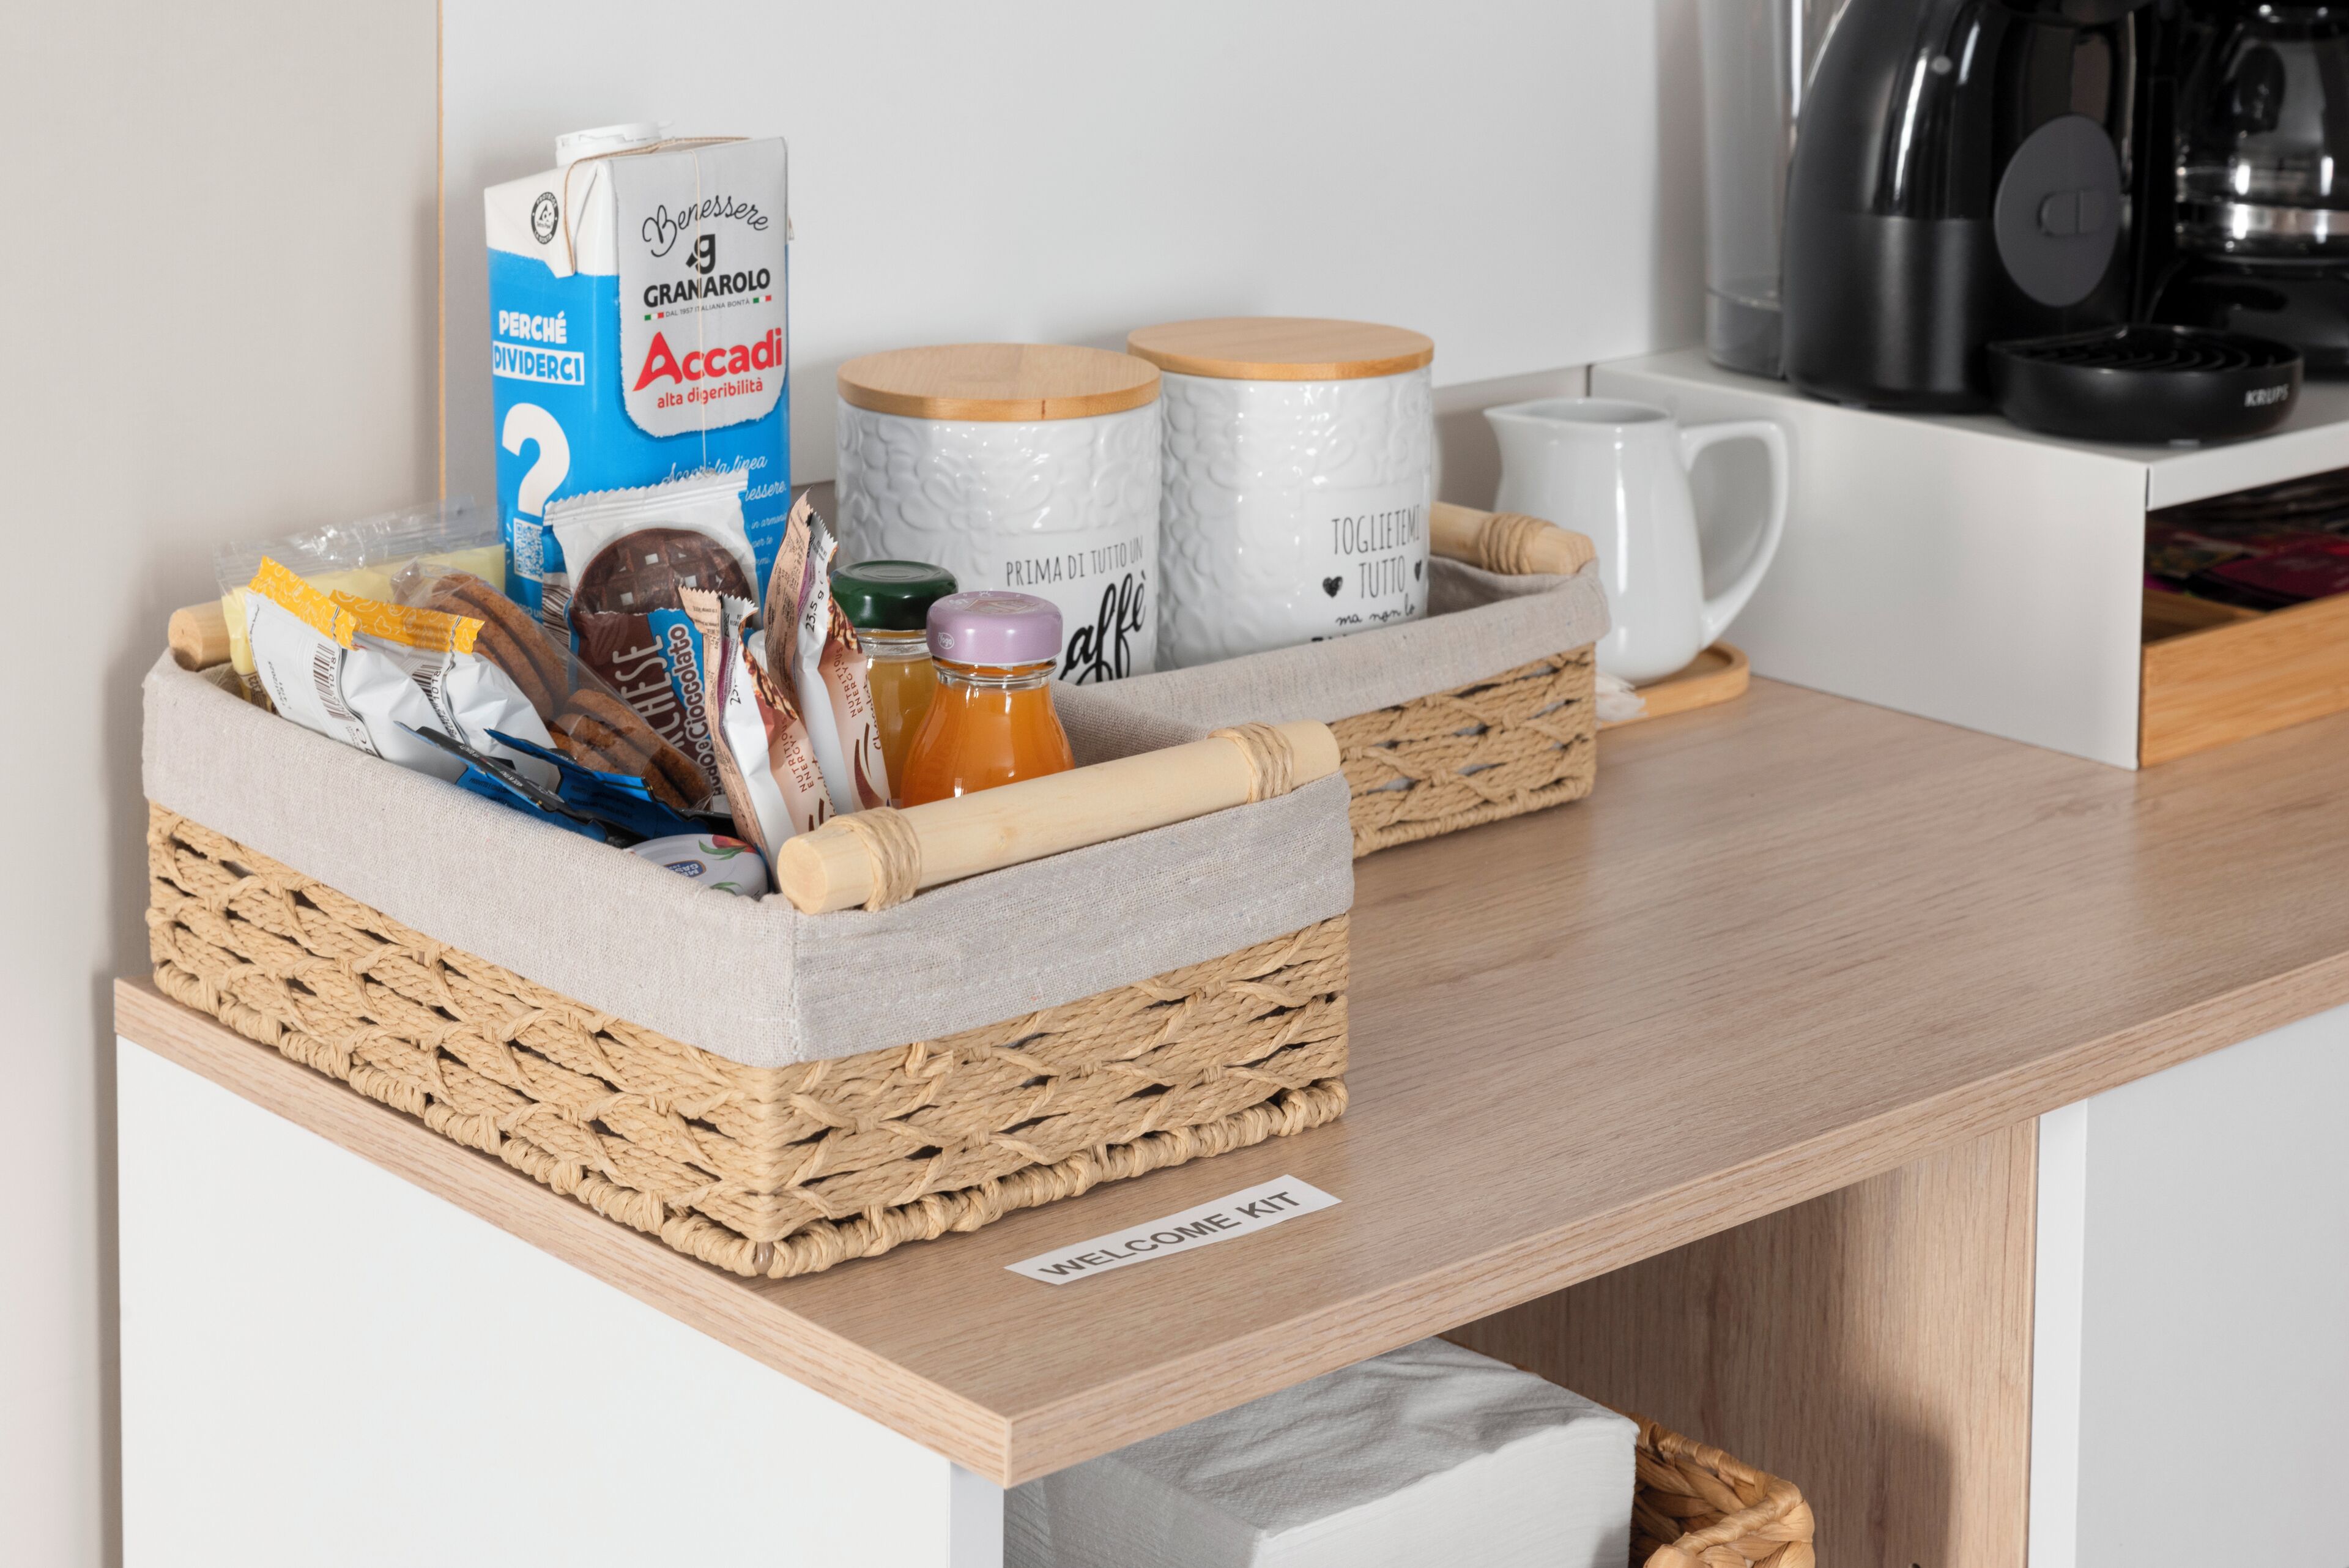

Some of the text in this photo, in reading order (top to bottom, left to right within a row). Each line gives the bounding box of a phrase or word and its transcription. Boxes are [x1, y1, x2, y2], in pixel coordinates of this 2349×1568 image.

[642, 195, 768, 258] Benessere
[644, 269, 770, 308] GRANAROLO
[499, 310, 567, 344] PERCHÉ
[494, 345, 582, 382] DIVIDERCI
[632, 327, 782, 392] Accadi
[657, 377, 763, 409] alta digeribilità
[2244, 384, 2288, 407] KRUPS
[715, 458, 730, 474] la
[733, 455, 768, 472] linea
[1332, 504, 1420, 555] TOGLIETEMI
[1006, 534, 1143, 587] PRIMA DI TUTTO UN
[1359, 555, 1406, 600] TUTTO
[1058, 569, 1147, 686] affè
[1335, 593, 1416, 626] ma non lo
[668, 625, 710, 741] Cioccolato
[834, 647, 858, 718] NUTRITIOUS
[781, 717, 808, 793] NUTRITIOUS
[1038, 1191, 1302, 1276] WELCOME KIT
